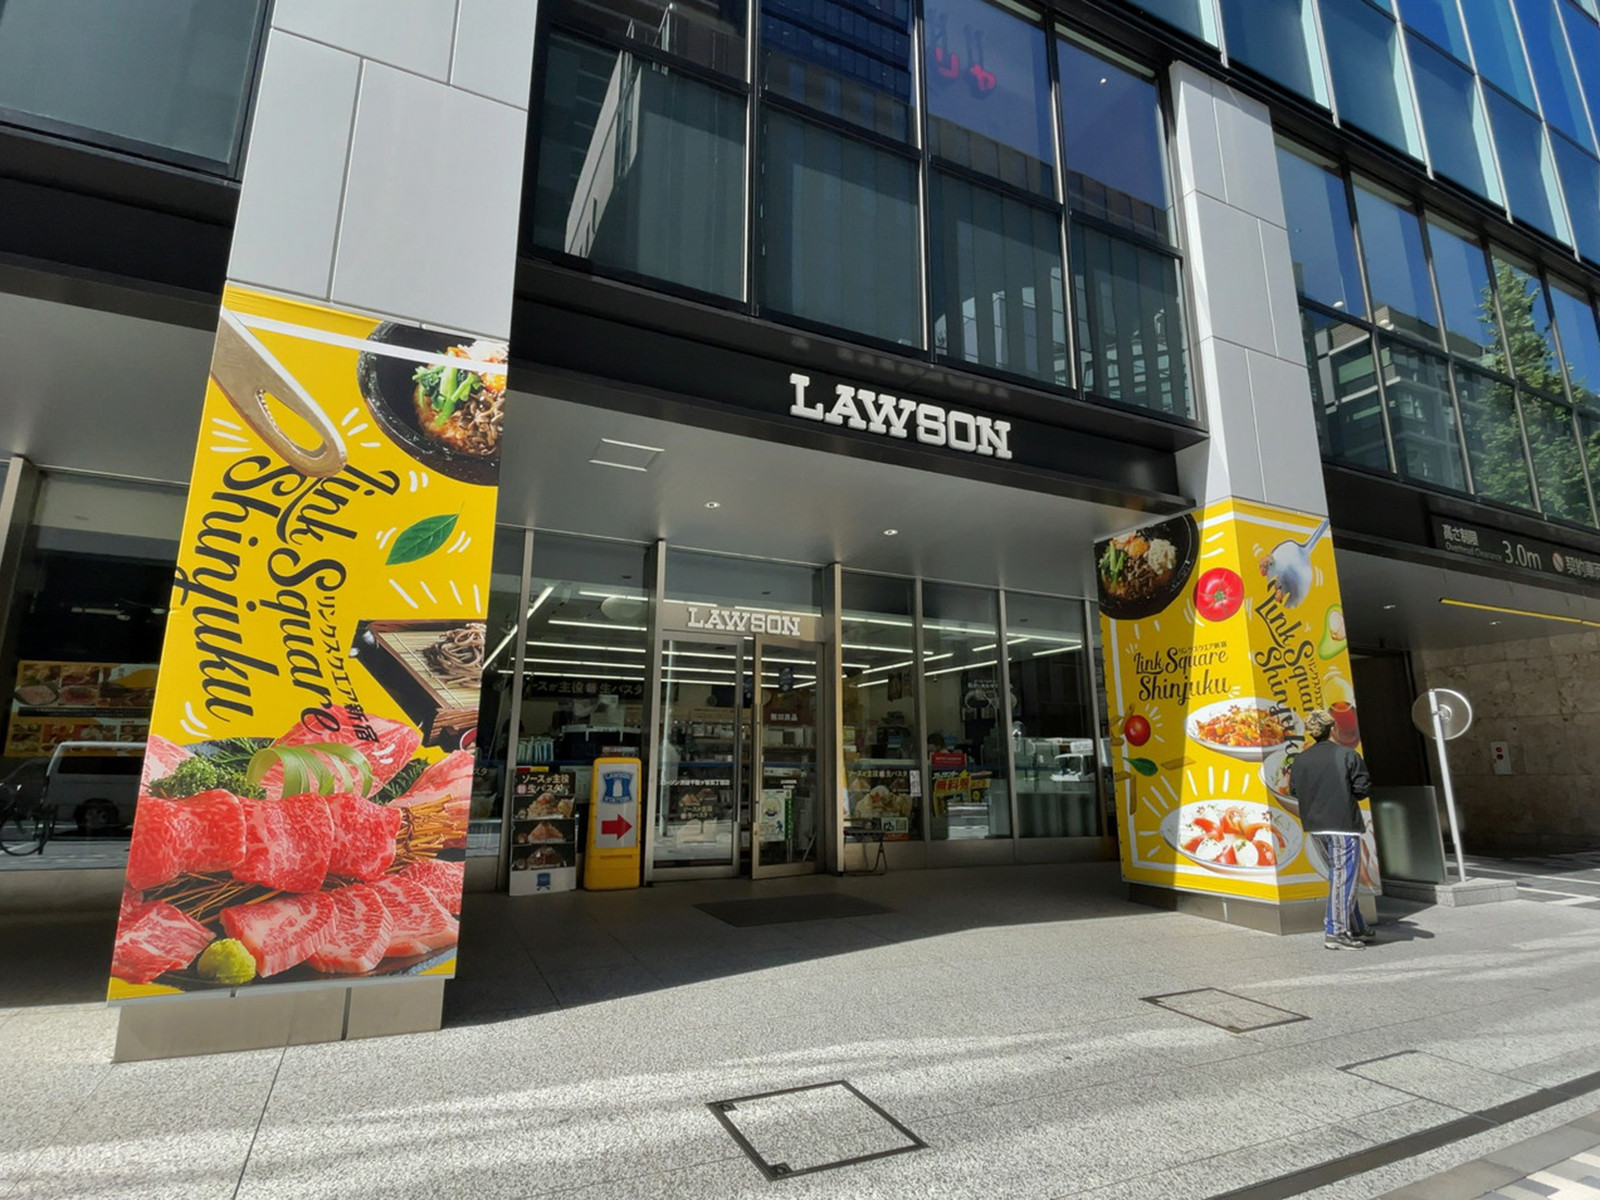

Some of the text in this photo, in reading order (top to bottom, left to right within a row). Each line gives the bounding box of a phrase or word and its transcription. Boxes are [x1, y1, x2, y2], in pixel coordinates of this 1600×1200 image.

[789, 372, 1013, 460] LAWSON
[174, 455, 307, 723] Shinjuku
[1501, 540, 1542, 571] 3.0m
[259, 464, 400, 736] Link Square
[687, 607, 800, 636] LAWSON
[1255, 579, 1302, 649] Link
[317, 595, 379, 743] リンクスクエア新宿
[1133, 647, 1229, 675] Link Square
[1138, 669, 1231, 706] Shinjuku
[1255, 646, 1306, 755] Shinjuk
